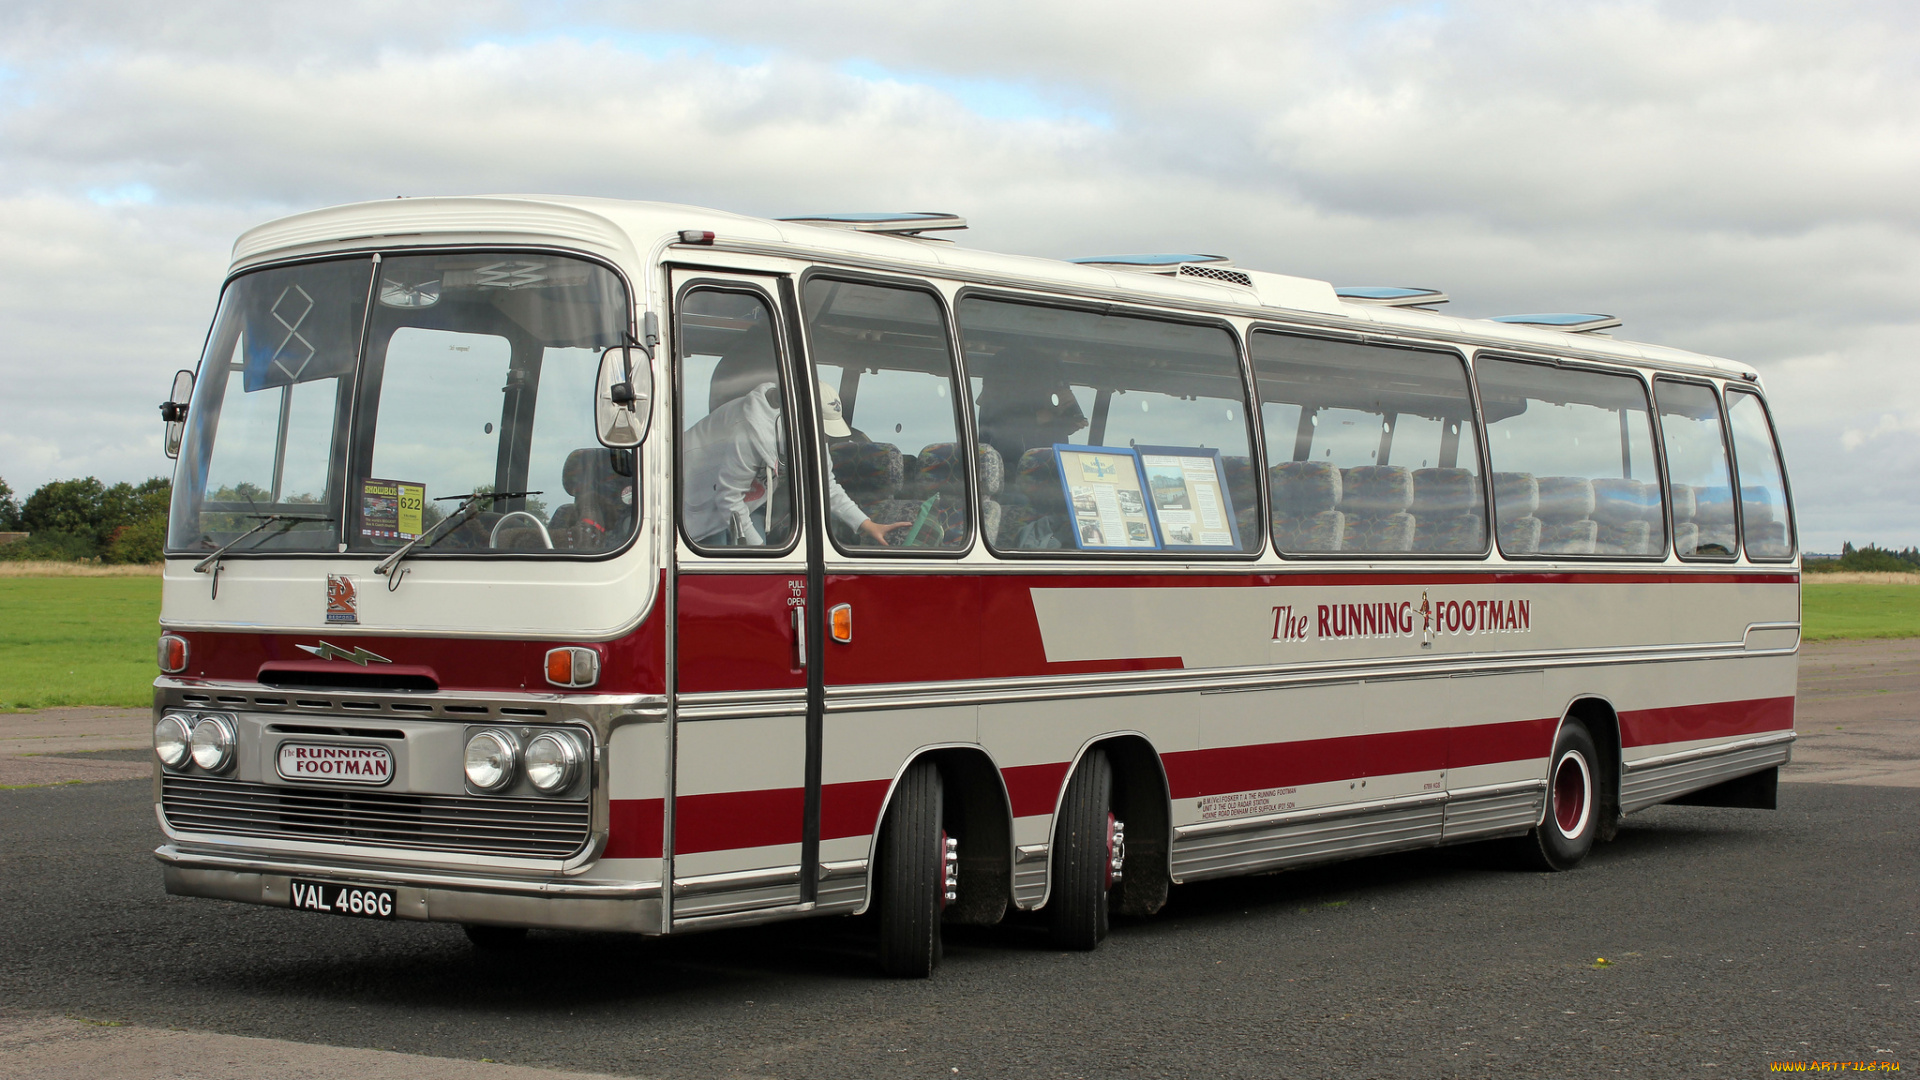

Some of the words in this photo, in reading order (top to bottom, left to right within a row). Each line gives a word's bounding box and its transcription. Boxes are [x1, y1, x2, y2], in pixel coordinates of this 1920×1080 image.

[365, 485, 397, 495] SHOWBUS
[400, 497, 421, 511] 622
[788, 580, 805, 588] PULL
[787, 597, 805, 605] OPEN
[1271, 605, 1309, 642] The
[1317, 601, 1414, 640] RUNNING
[1436, 600, 1531, 634] FOOTMAN
[284, 749, 295, 758] The
[296, 747, 386, 759] RUNNING
[296, 759, 387, 776] FOOTMAN
[1257, 790, 1276, 798] RUNNING
[1277, 787, 1296, 795] FOOTMAN
[1202, 804, 1212, 812] UNIT
[1238, 799, 1252, 807] RADAR
[1252, 798, 1269, 806] STATION
[1218, 809, 1231, 818] ROAD
[1231, 807, 1249, 816] DENHAM
[1258, 804, 1277, 813] SUFFOLK
[292, 883, 331, 911] VAL
[335, 888, 392, 916] 466G
